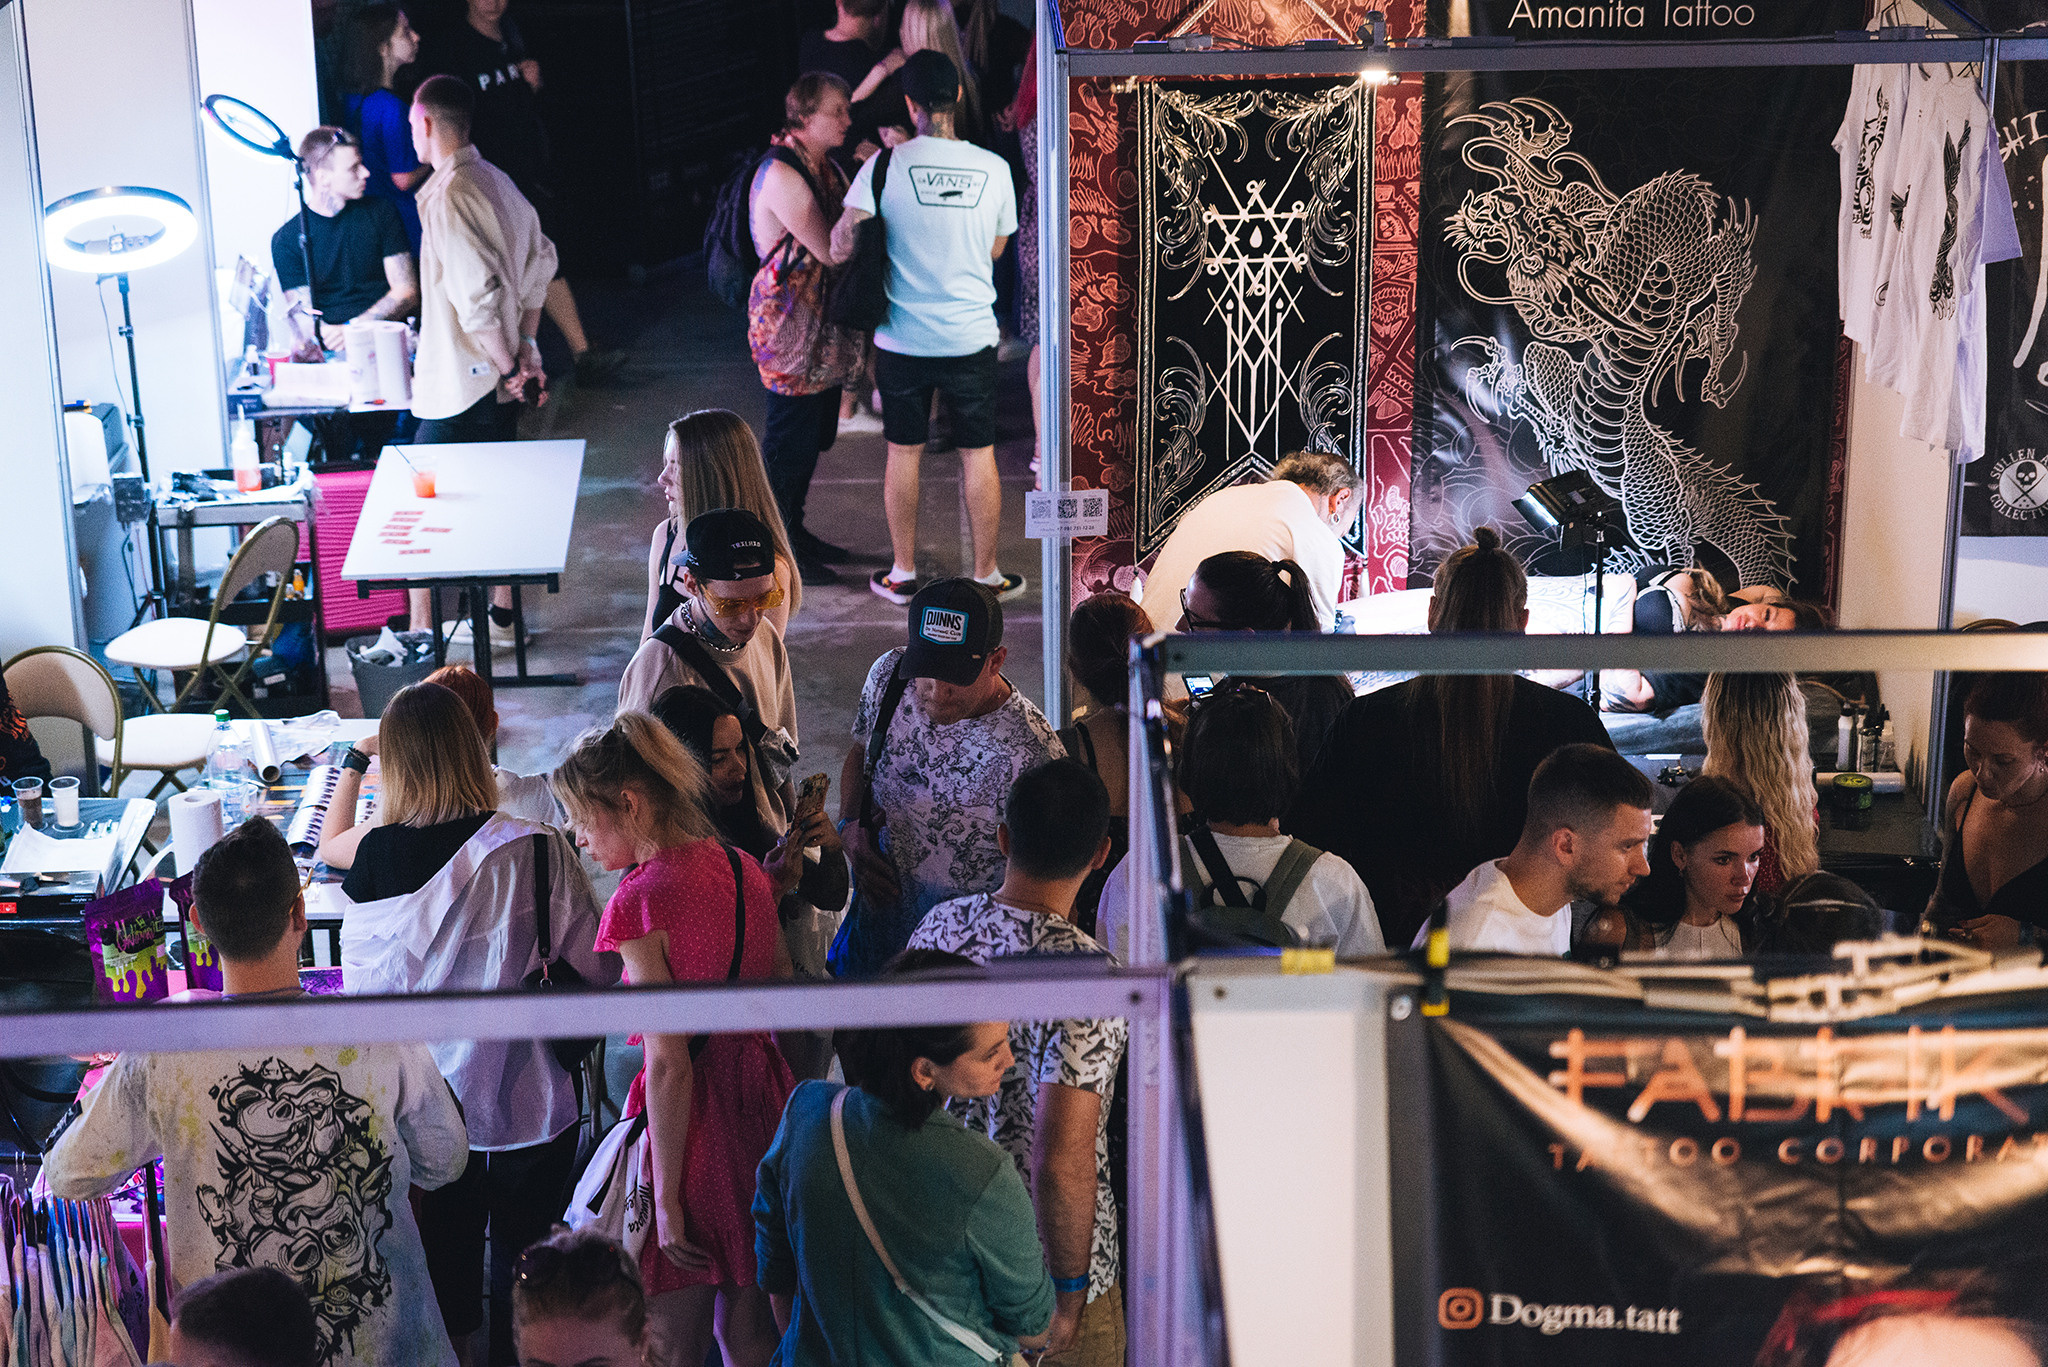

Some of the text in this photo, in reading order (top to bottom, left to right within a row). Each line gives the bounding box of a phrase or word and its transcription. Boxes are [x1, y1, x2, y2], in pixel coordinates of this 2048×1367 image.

[1507, 0, 1645, 29] Amanita
[926, 172, 973, 188] VANS
[1990, 447, 2036, 480] SULLEN
[1989, 493, 2048, 521] COLLECTI
[926, 611, 962, 630] DJINNS
[1548, 1026, 2030, 1124] FABRIK
[1490, 1293, 1681, 1335] Dogma.tatt
